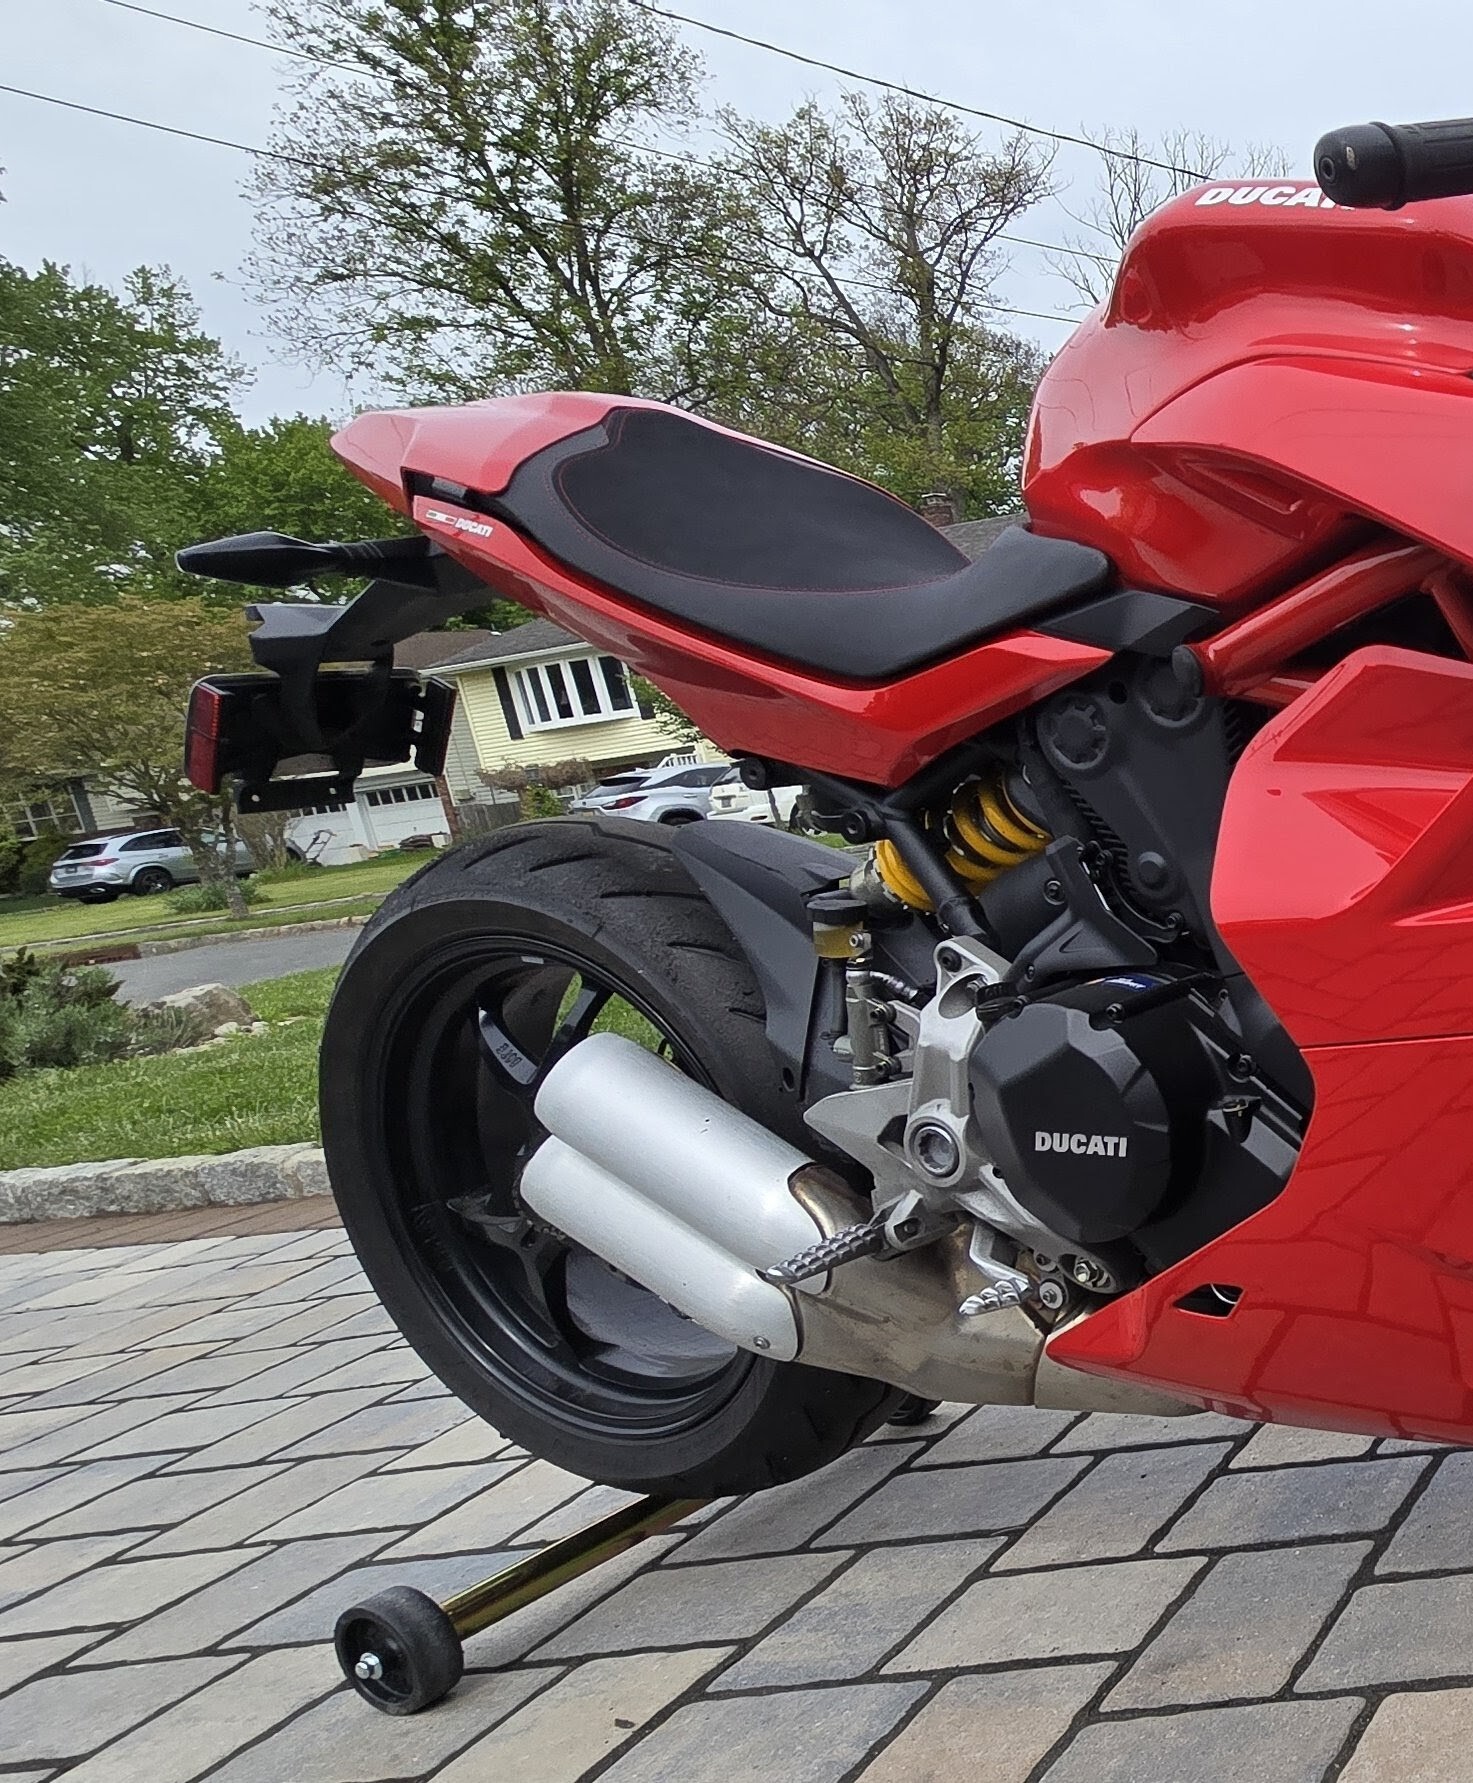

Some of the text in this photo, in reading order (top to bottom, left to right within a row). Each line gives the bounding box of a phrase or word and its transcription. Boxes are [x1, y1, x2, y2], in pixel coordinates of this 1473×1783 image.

[1194, 186, 1355, 210] DUCA
[455, 518, 493, 537] DUCATI
[1035, 1131, 1128, 1157] DUCATI
